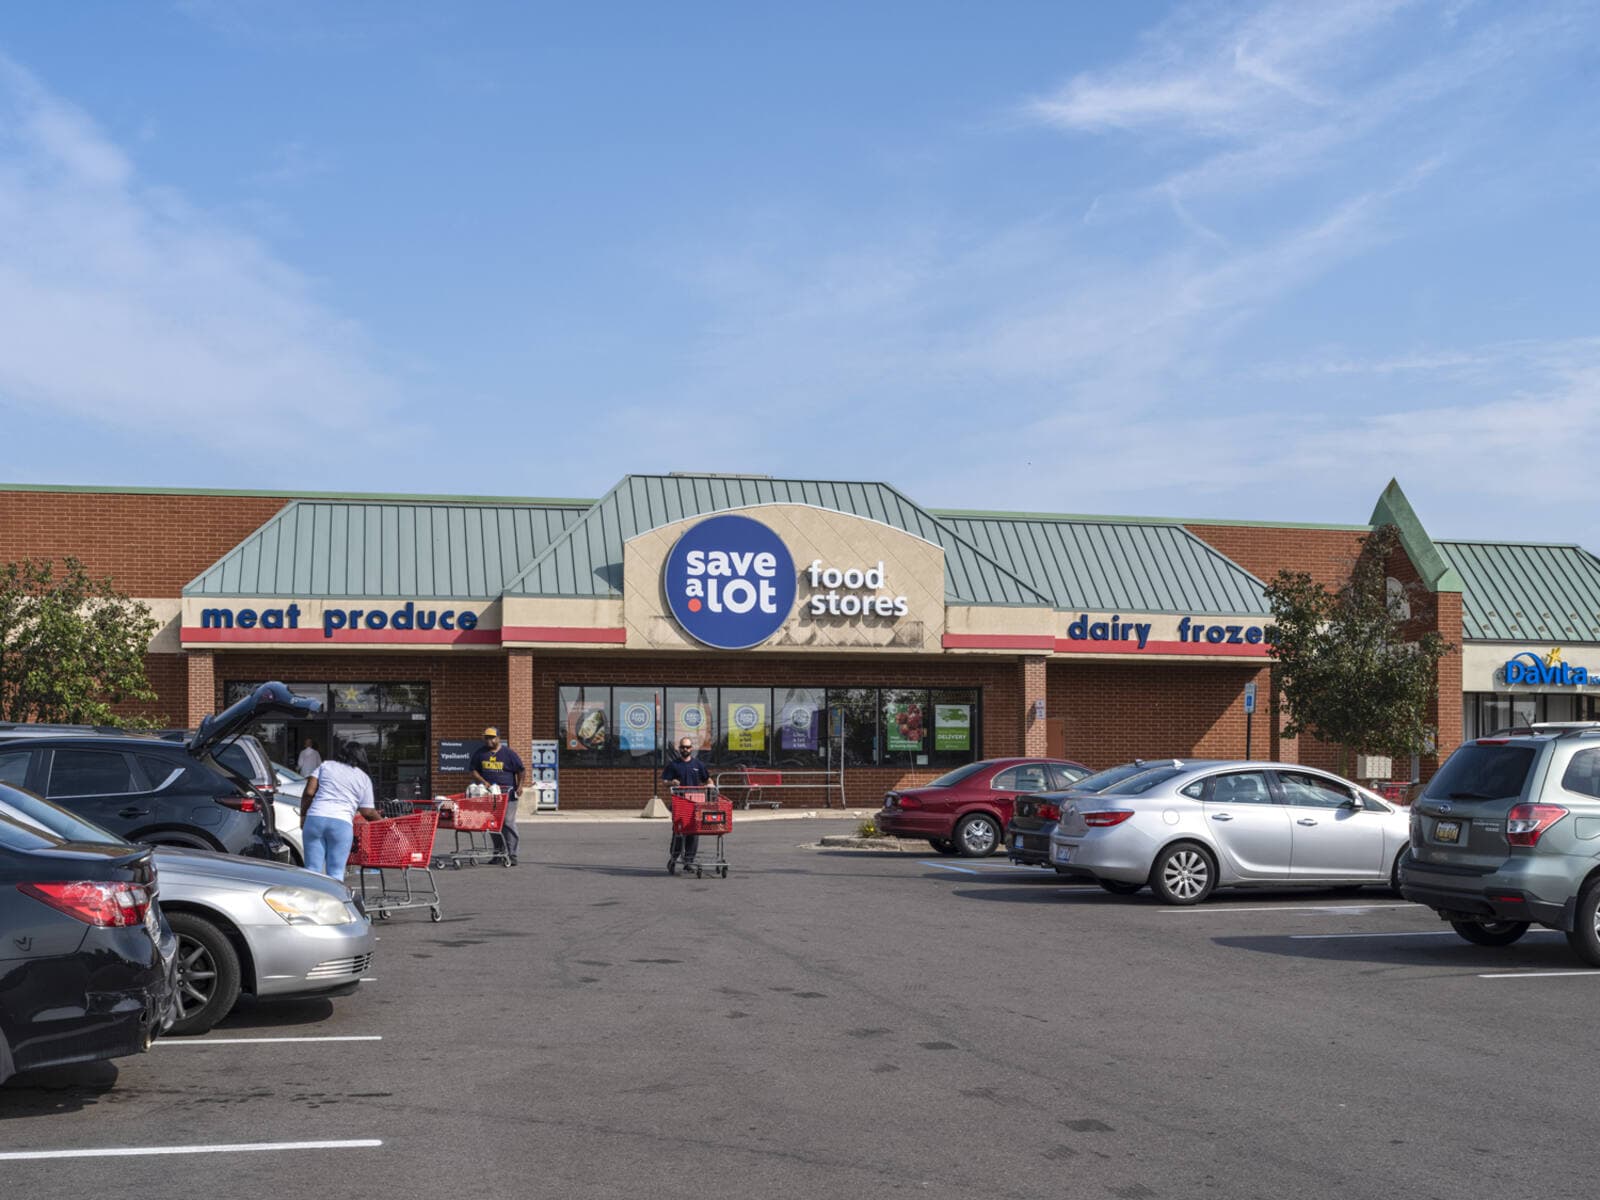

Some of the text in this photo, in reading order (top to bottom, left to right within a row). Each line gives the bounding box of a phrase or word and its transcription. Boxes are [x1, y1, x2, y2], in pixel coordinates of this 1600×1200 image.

[686, 551, 777, 577] save
[808, 559, 885, 590] food
[685, 578, 704, 597] a
[811, 590, 909, 617] stores
[201, 601, 478, 638] meat produce
[1067, 614, 1152, 649] dairy
[1505, 651, 1588, 686] DaVita
[440, 752, 470, 760] Ypsilanti
